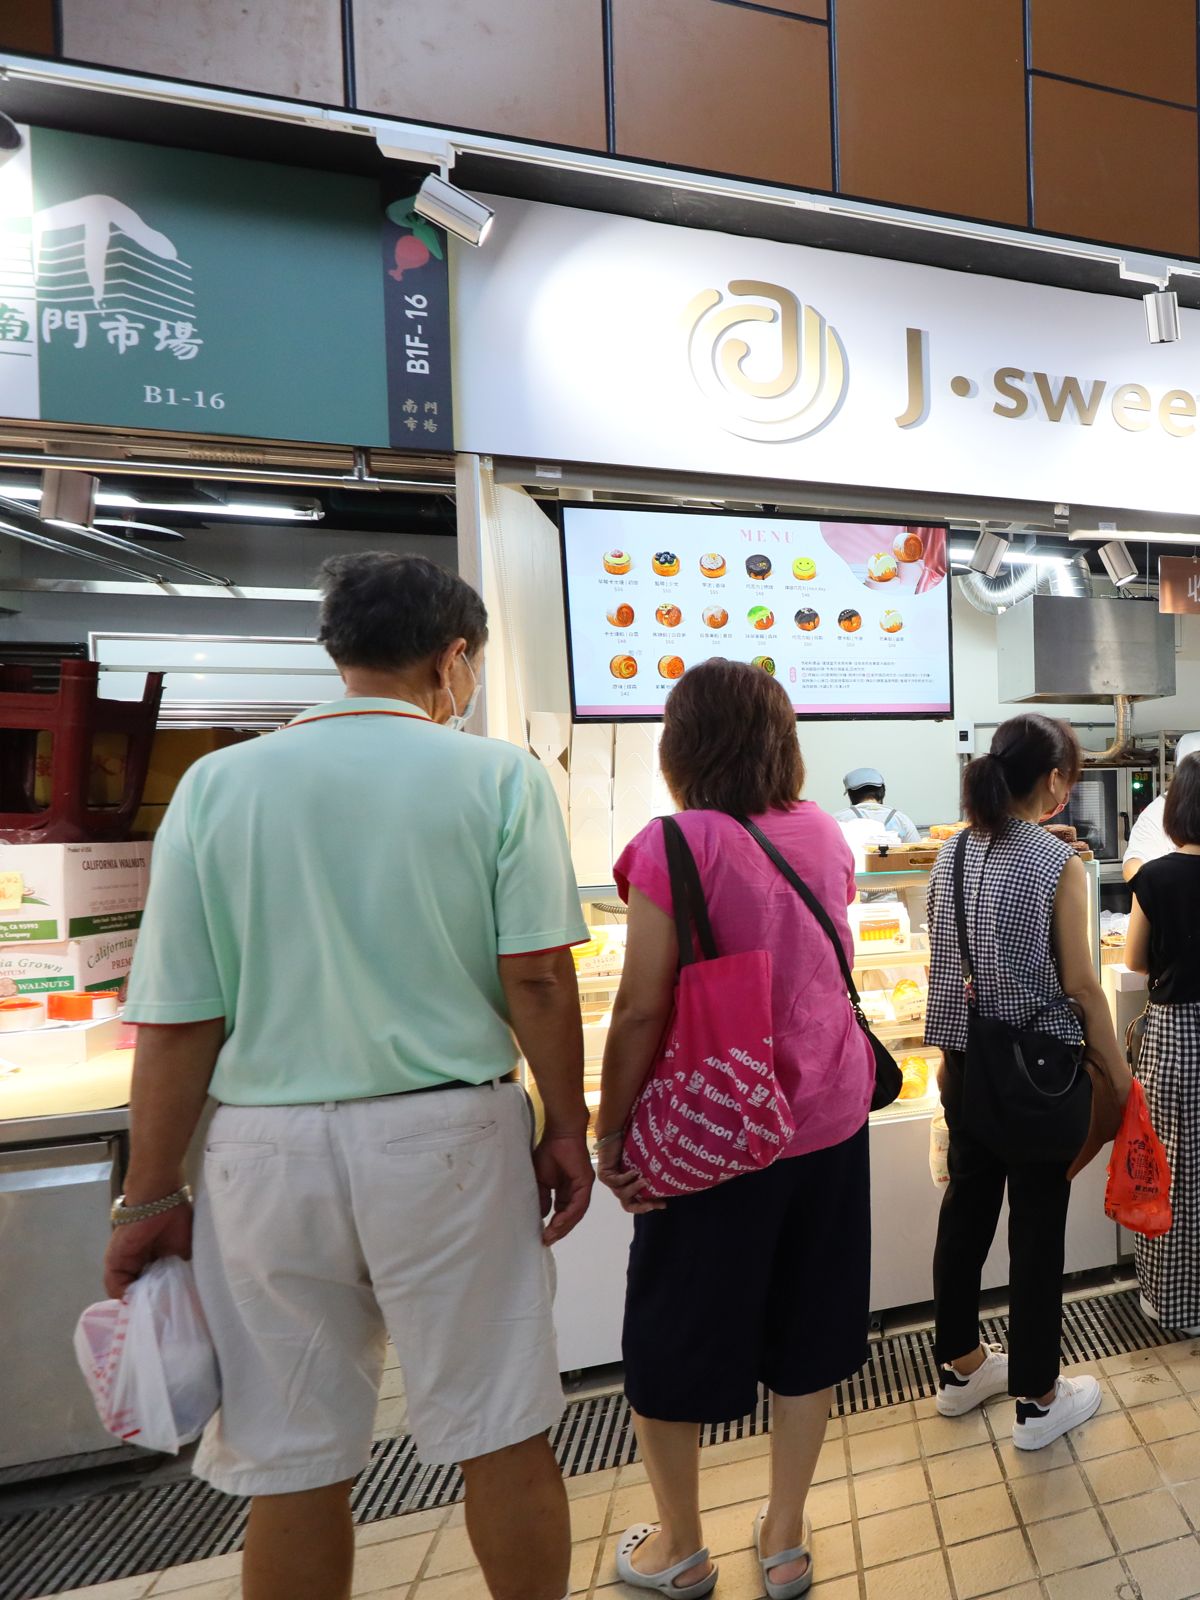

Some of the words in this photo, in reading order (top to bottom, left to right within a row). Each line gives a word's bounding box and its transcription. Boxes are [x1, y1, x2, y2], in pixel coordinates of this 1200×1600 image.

[406, 293, 430, 374] B1F-16
[143, 385, 226, 410] B1-16
[740, 528, 796, 544] MENU
[82, 859, 118, 871] CALIFORNIA
[119, 857, 146, 869] WALNUTS
[87, 937, 133, 969] California
[18, 958, 63, 973] Grown
[111, 957, 132, 970] PREM
[18, 980, 70, 991] WALNUTS
[678, 1135, 726, 1168] Kinloch
